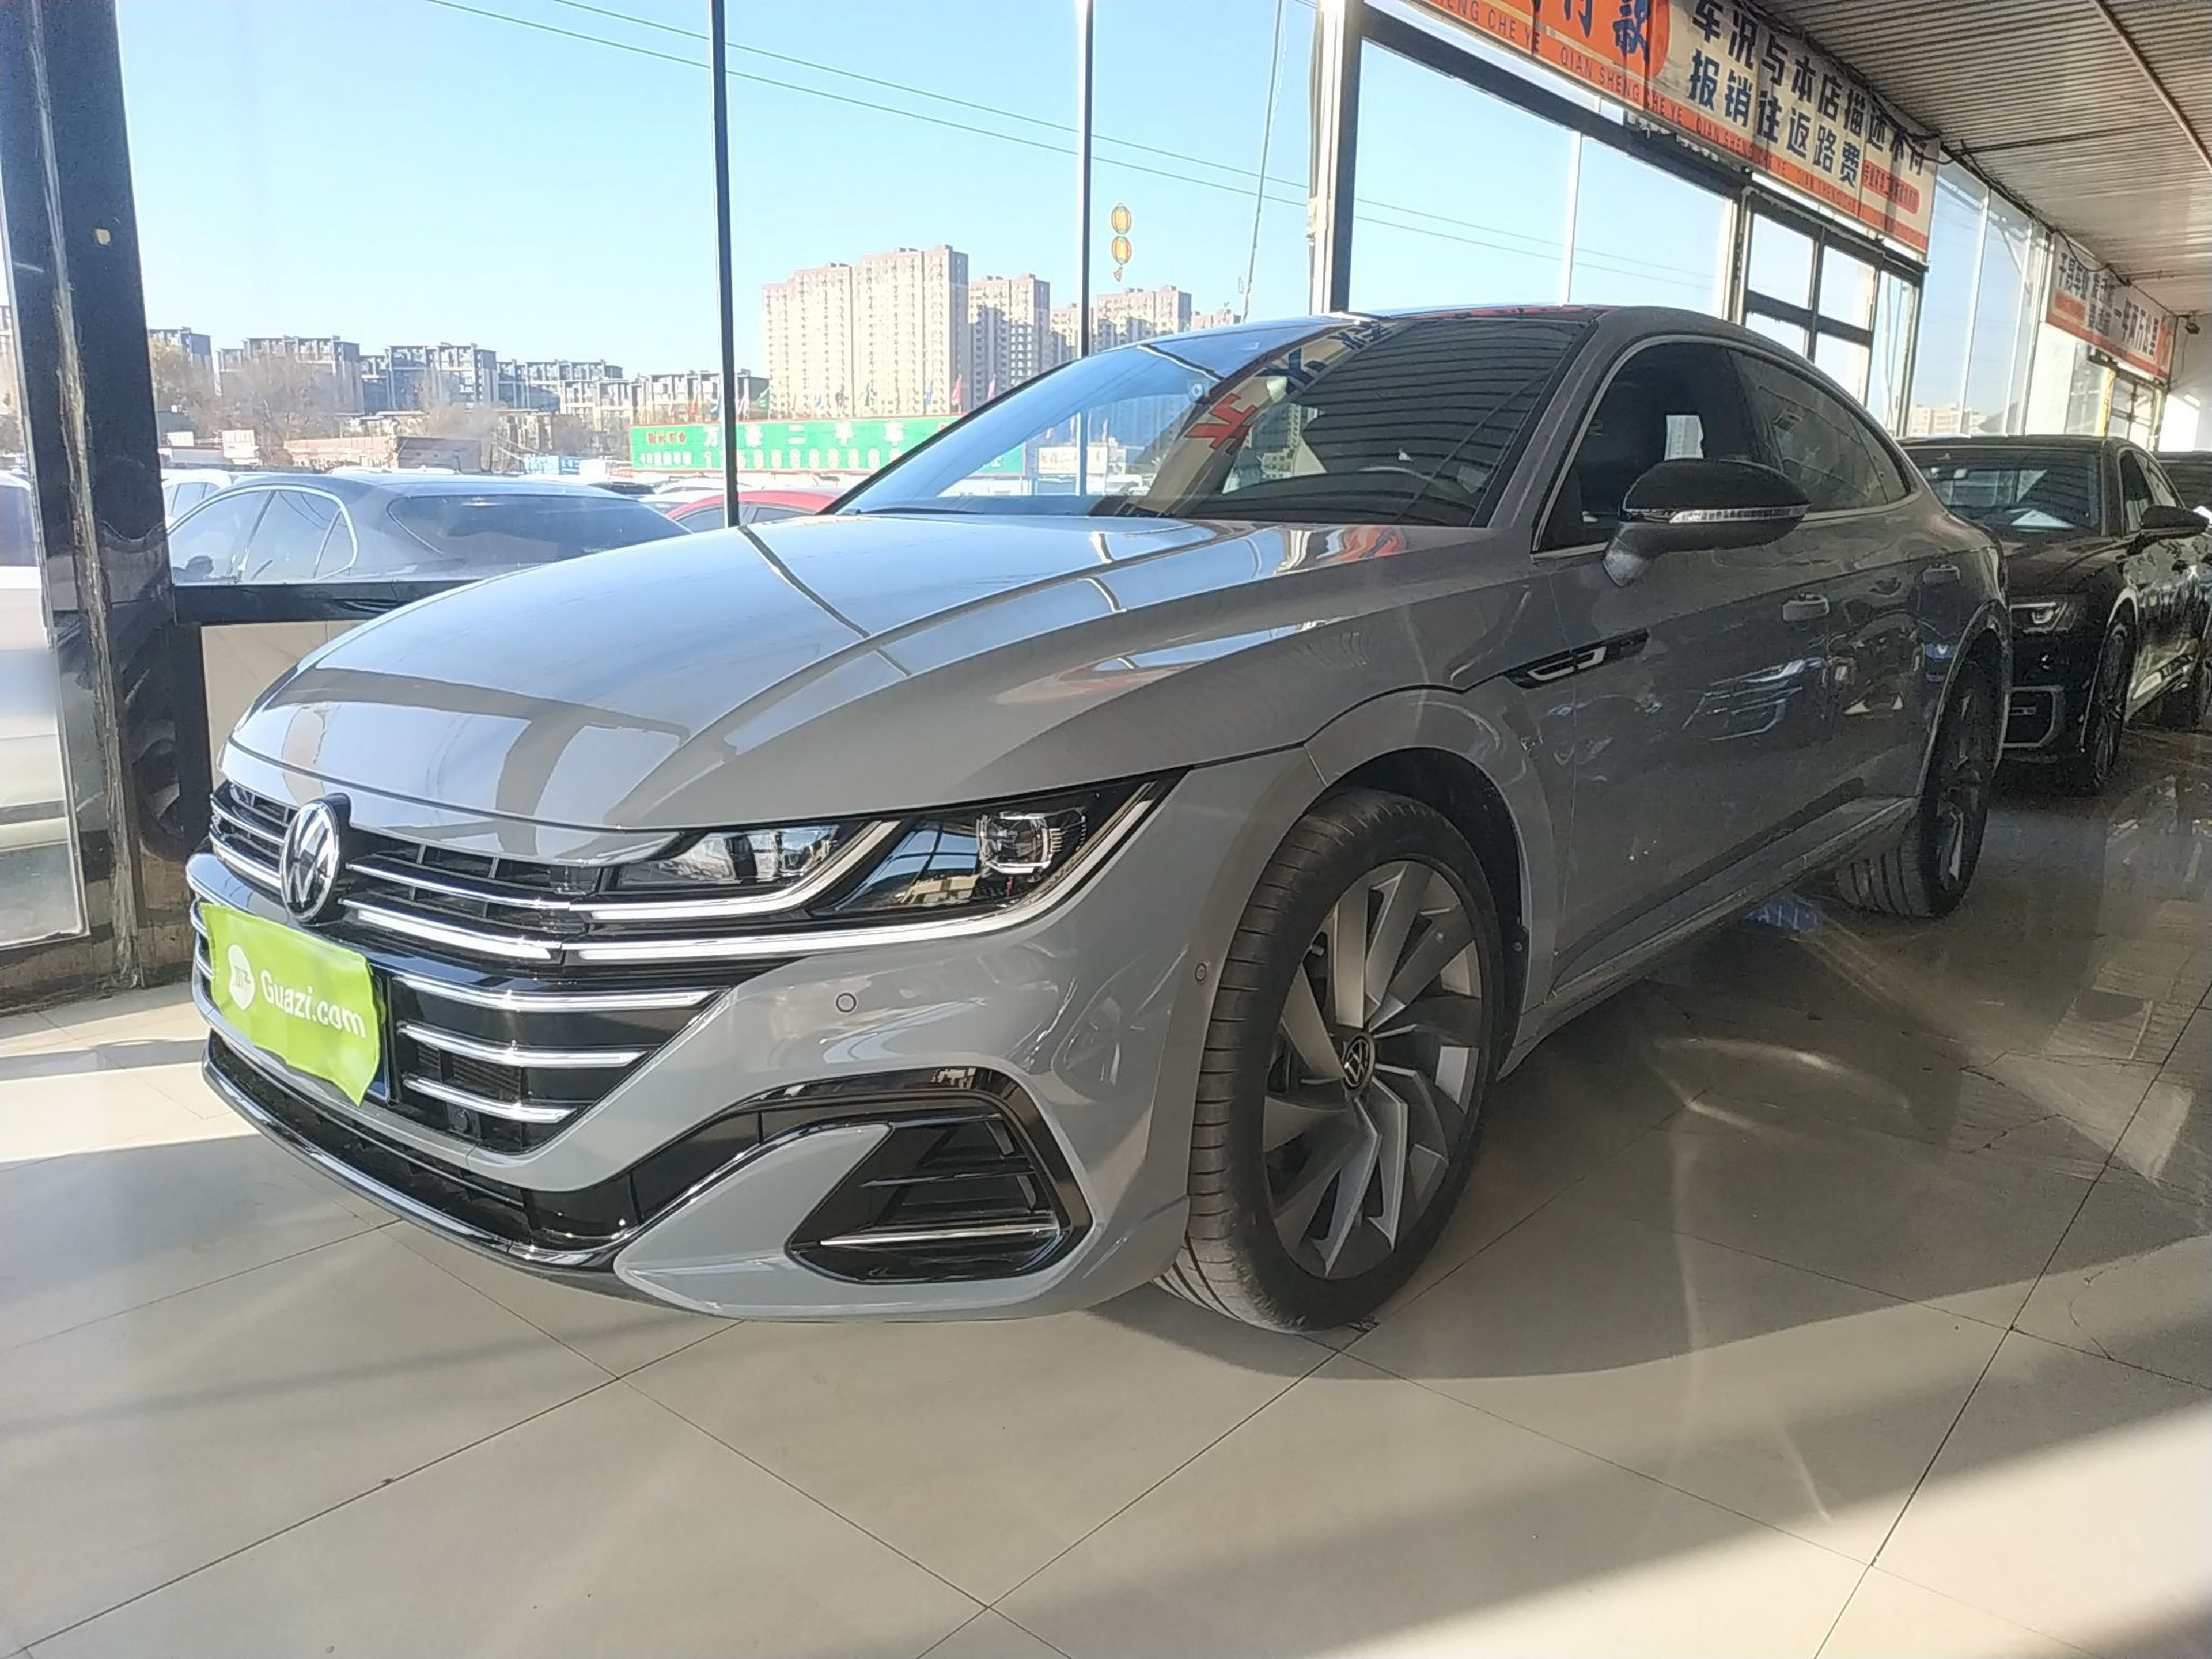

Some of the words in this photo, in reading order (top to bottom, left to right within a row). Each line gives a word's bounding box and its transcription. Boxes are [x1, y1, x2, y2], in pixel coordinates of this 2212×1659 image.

[1488, 9, 1516, 40] CHE
[1560, 46, 1592, 79] QIAN
[1599, 66, 1640, 101] SHENG
[1647, 88, 1665, 116] HE
[1688, 48, 1860, 188] 报销往返路费
[260, 969, 366, 1039] Guazi.com
